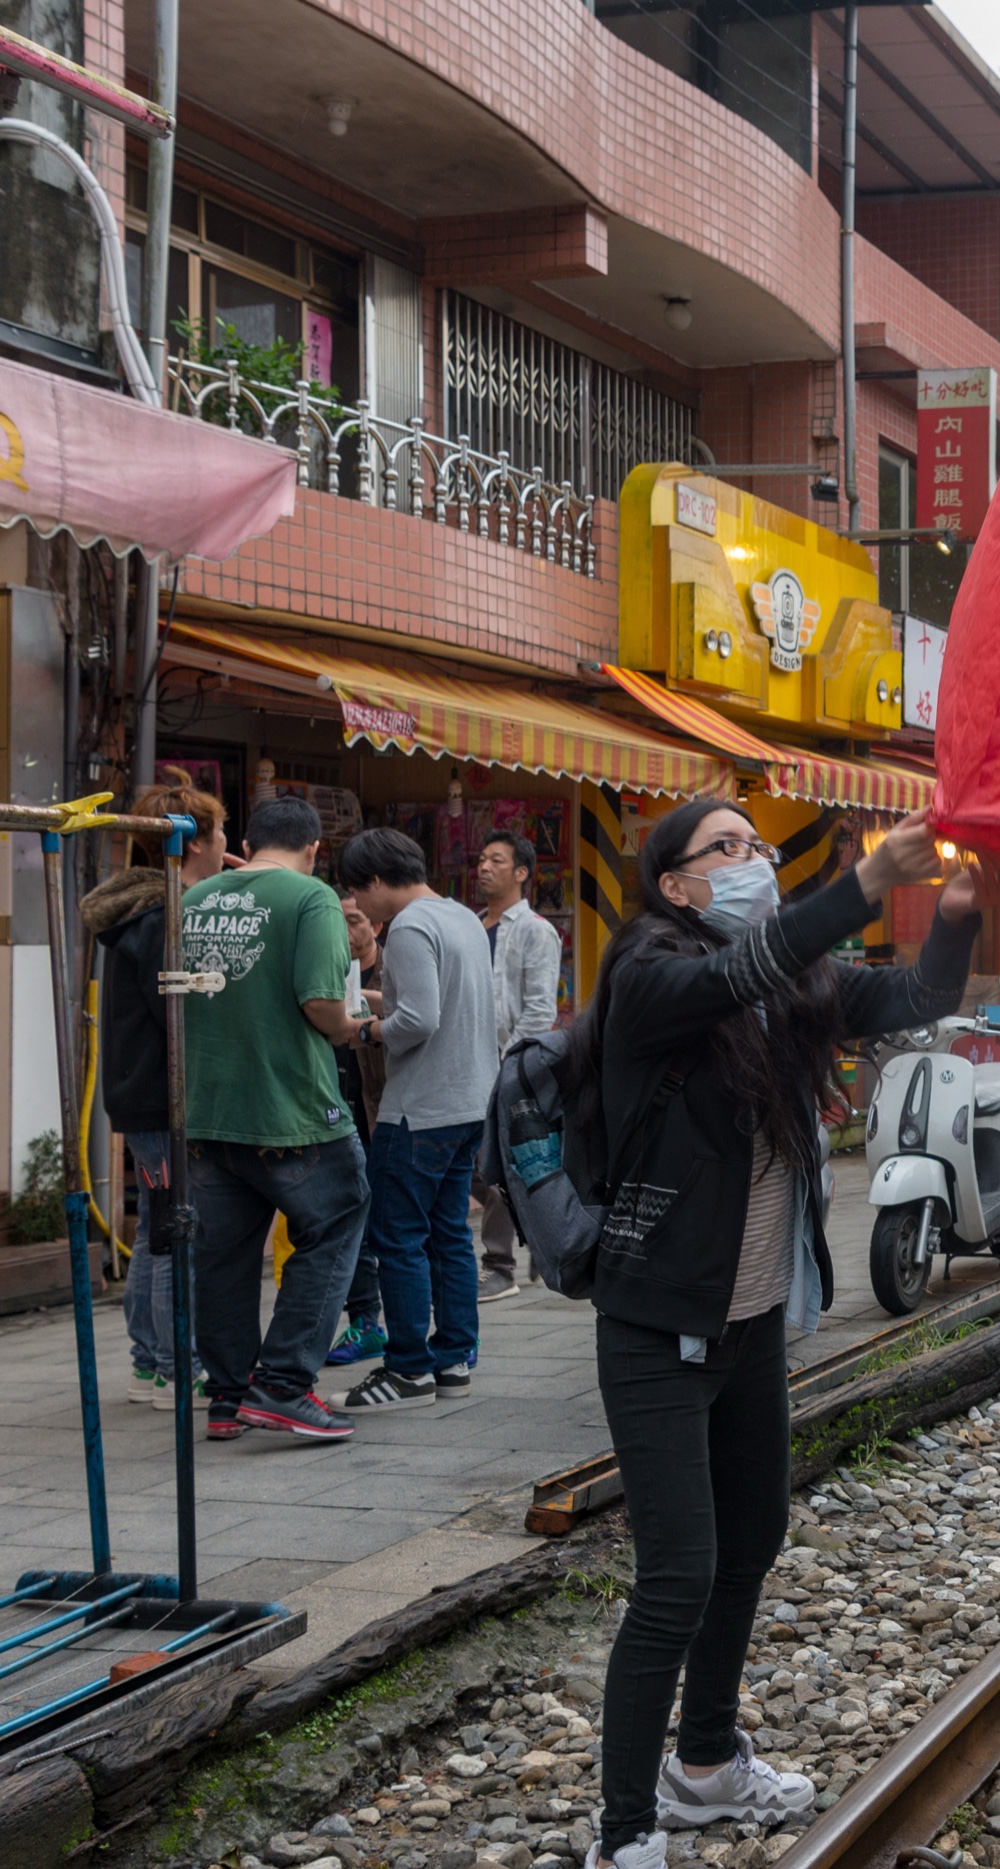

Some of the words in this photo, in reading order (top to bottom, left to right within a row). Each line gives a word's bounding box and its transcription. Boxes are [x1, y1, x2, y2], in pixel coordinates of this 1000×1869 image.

[919, 379, 988, 401] 十分好吃
[773, 651, 801, 670] DESIGN
[182, 914, 262, 936] ALAPAGE
[185, 934, 252, 944] IMPORTANT
